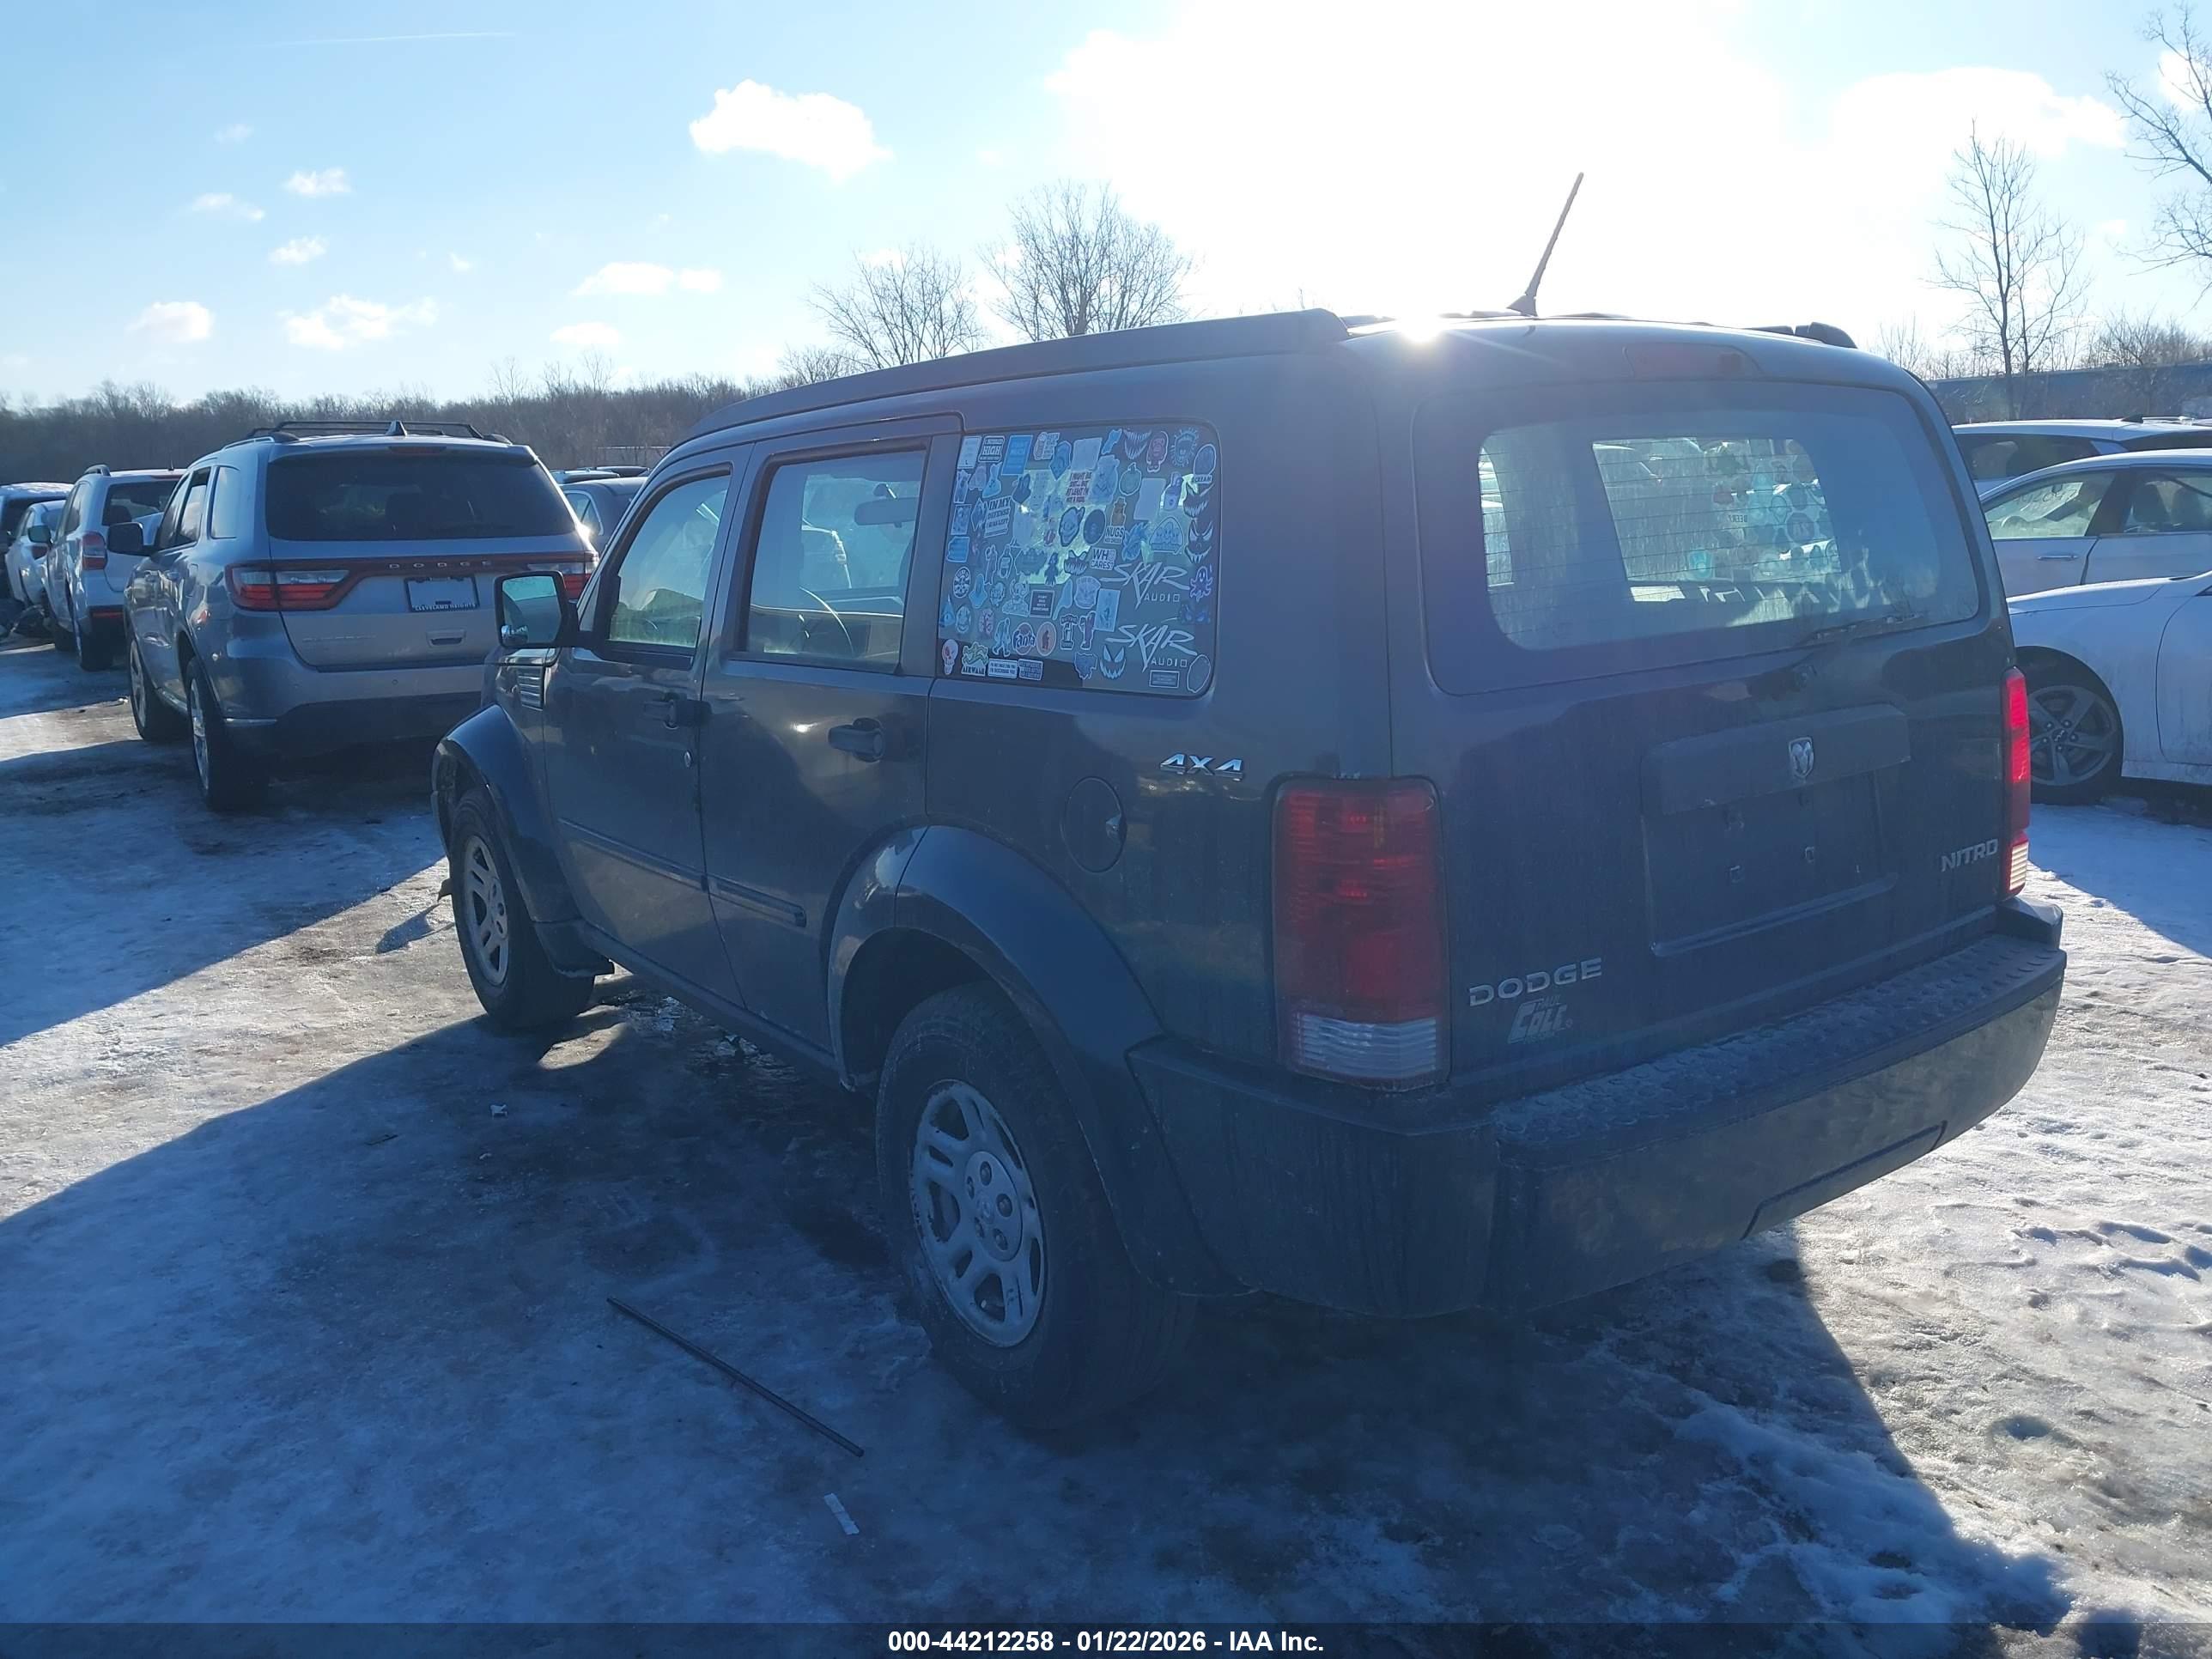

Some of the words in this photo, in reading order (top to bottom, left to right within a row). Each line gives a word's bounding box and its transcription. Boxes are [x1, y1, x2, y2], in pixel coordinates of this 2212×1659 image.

[1106, 526, 1124, 538] NUGS
[1099, 562, 1191, 610] SKAR
[1144, 593, 1181, 602] AUDIO
[1104, 623, 1199, 672] SKAR
[1151, 658, 1188, 668] AUDIO
[1941, 838, 1999, 872] NITRO
[1469, 957, 1603, 1007] DODGE
